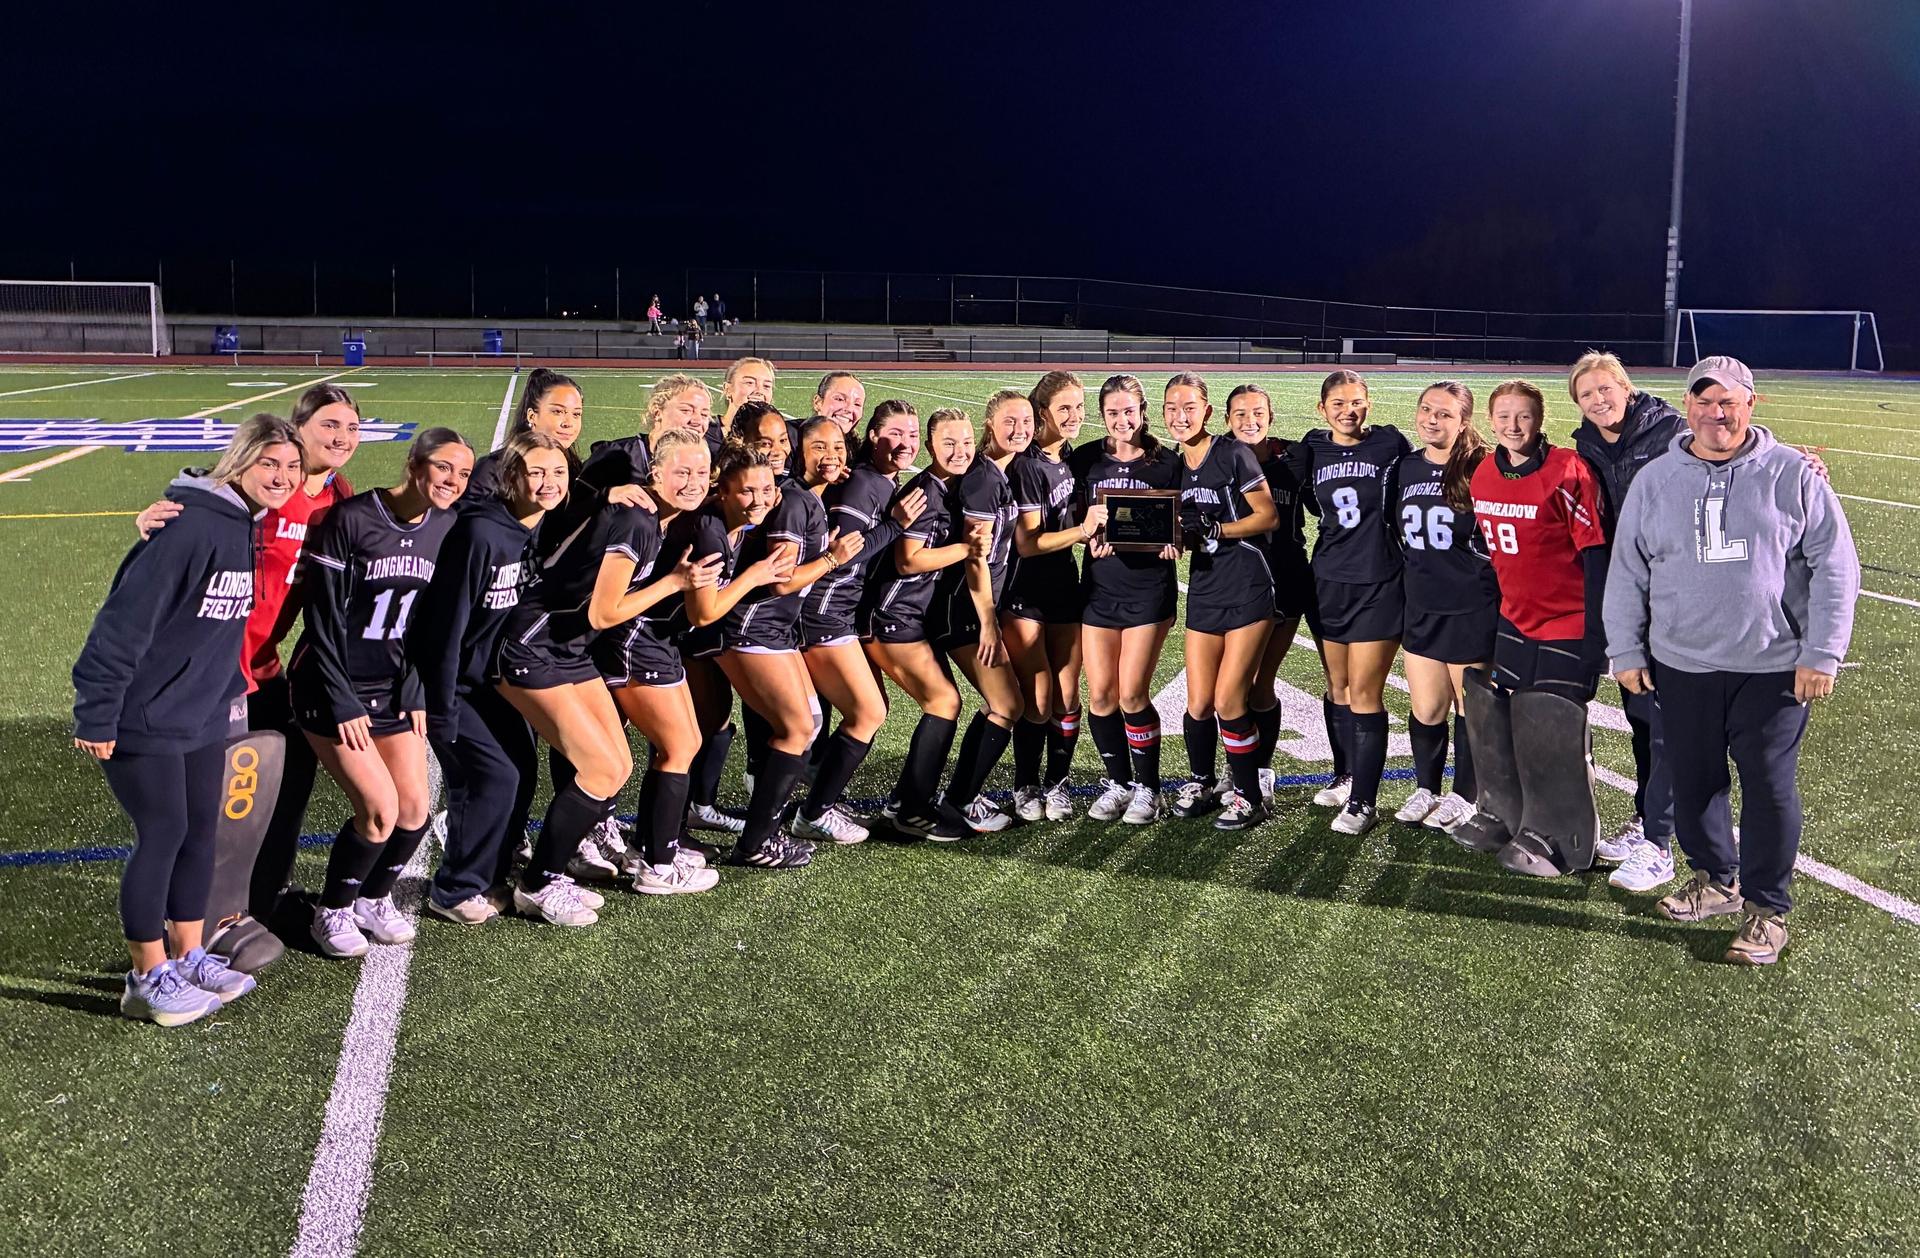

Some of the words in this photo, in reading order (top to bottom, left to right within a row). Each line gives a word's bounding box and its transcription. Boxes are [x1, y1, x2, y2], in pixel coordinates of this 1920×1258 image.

[1092, 477, 1153, 499] LONGMEADO
[1331, 486, 1361, 529] 8
[1401, 482, 1446, 501] LONGMEA
[1471, 496, 1539, 520] LONGMEADOW
[1401, 504, 1455, 551] 26
[1482, 519, 1519, 555] 28
[1703, 497, 1749, 563] L
[361, 588, 419, 640] 11
[225, 745, 260, 821] OBO
